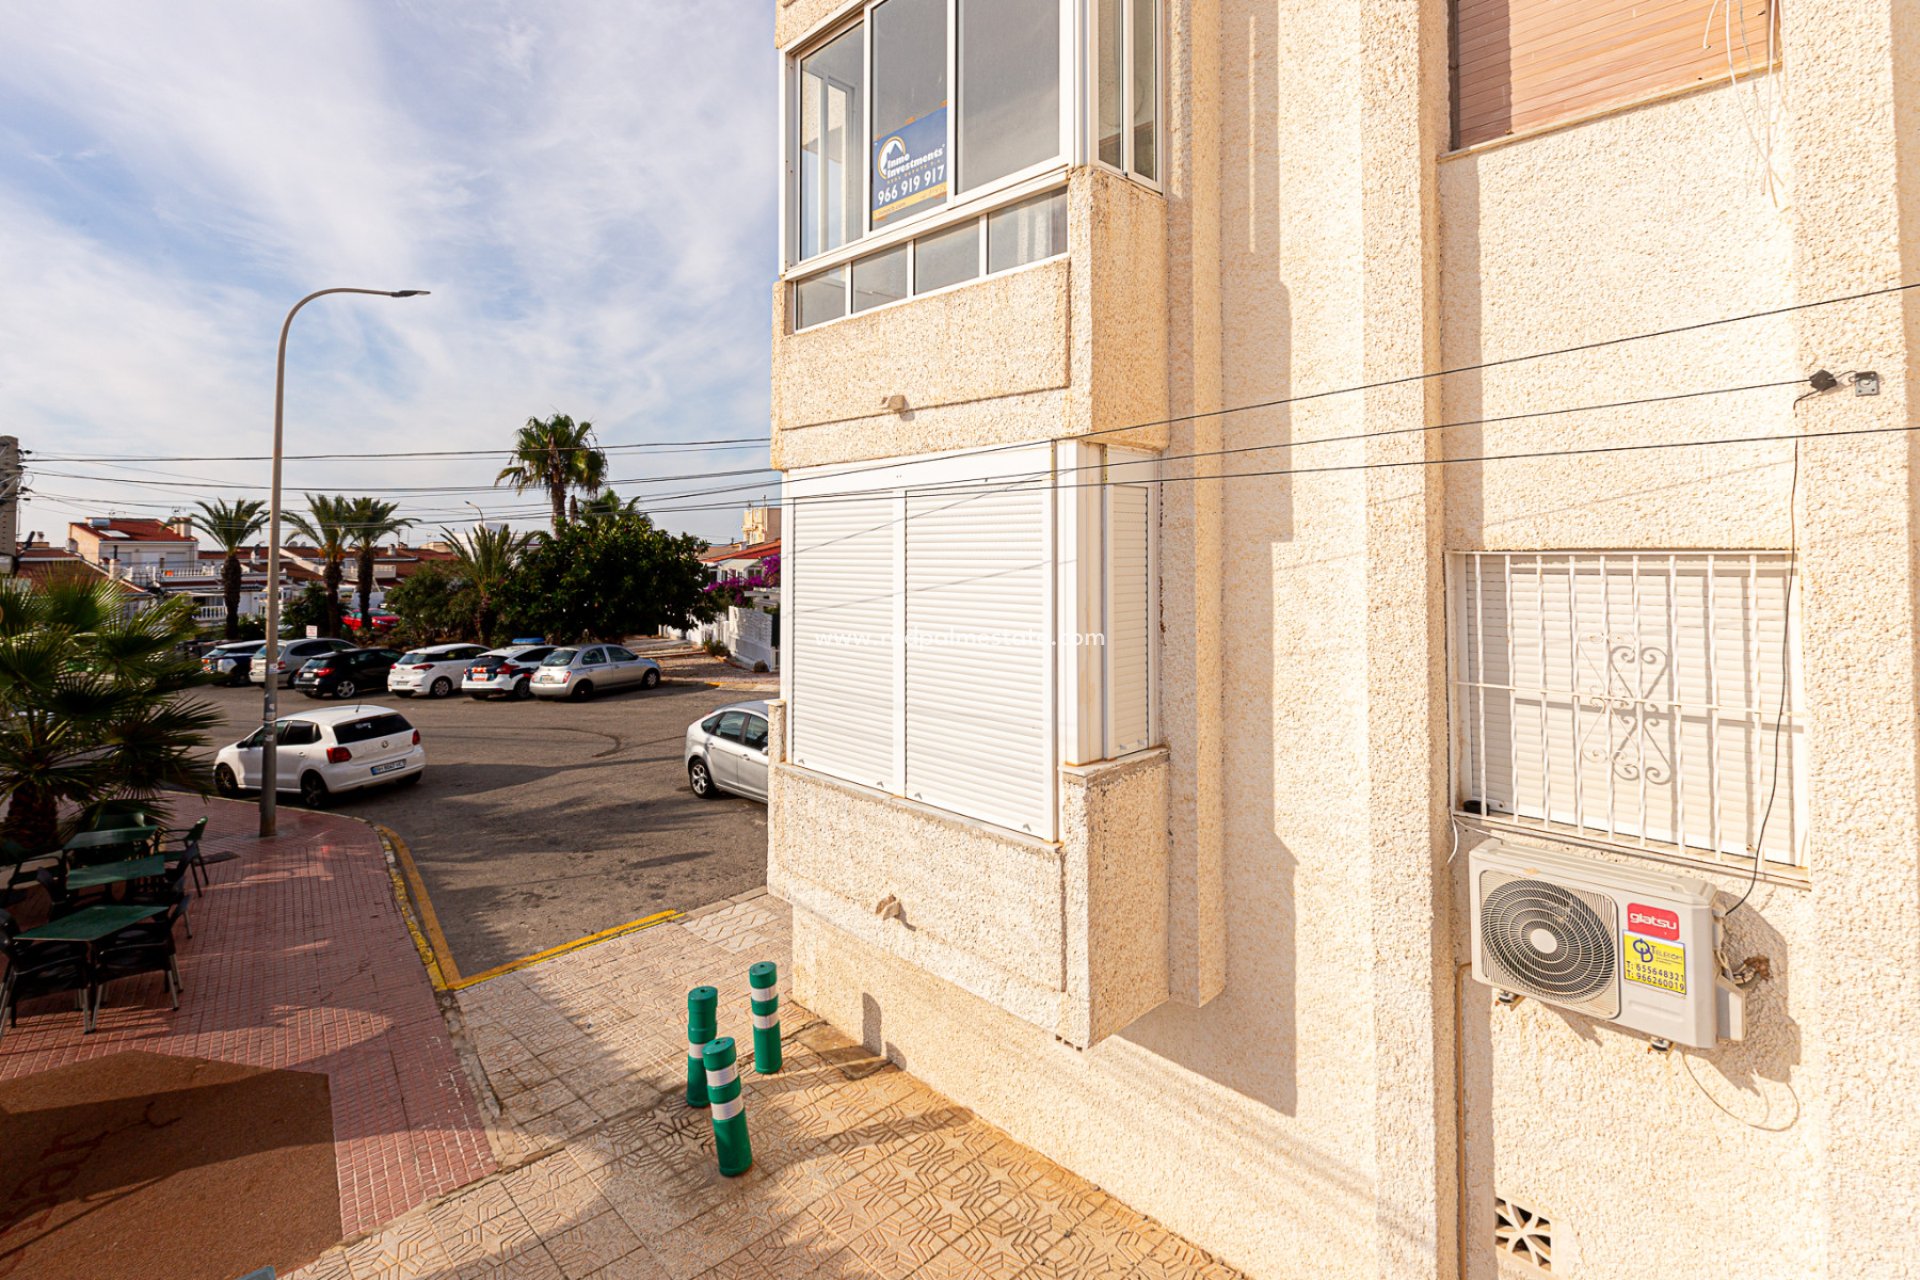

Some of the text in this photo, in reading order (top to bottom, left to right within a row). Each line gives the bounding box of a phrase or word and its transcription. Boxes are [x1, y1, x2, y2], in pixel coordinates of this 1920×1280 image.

[878, 184, 898, 206] 966
[901, 175, 921, 196] 919
[924, 164, 945, 186] 917
[1630, 913, 1676, 930] giatsu
[1636, 963, 1685, 982] 655648321
[1636, 972, 1686, 991] 966260019
